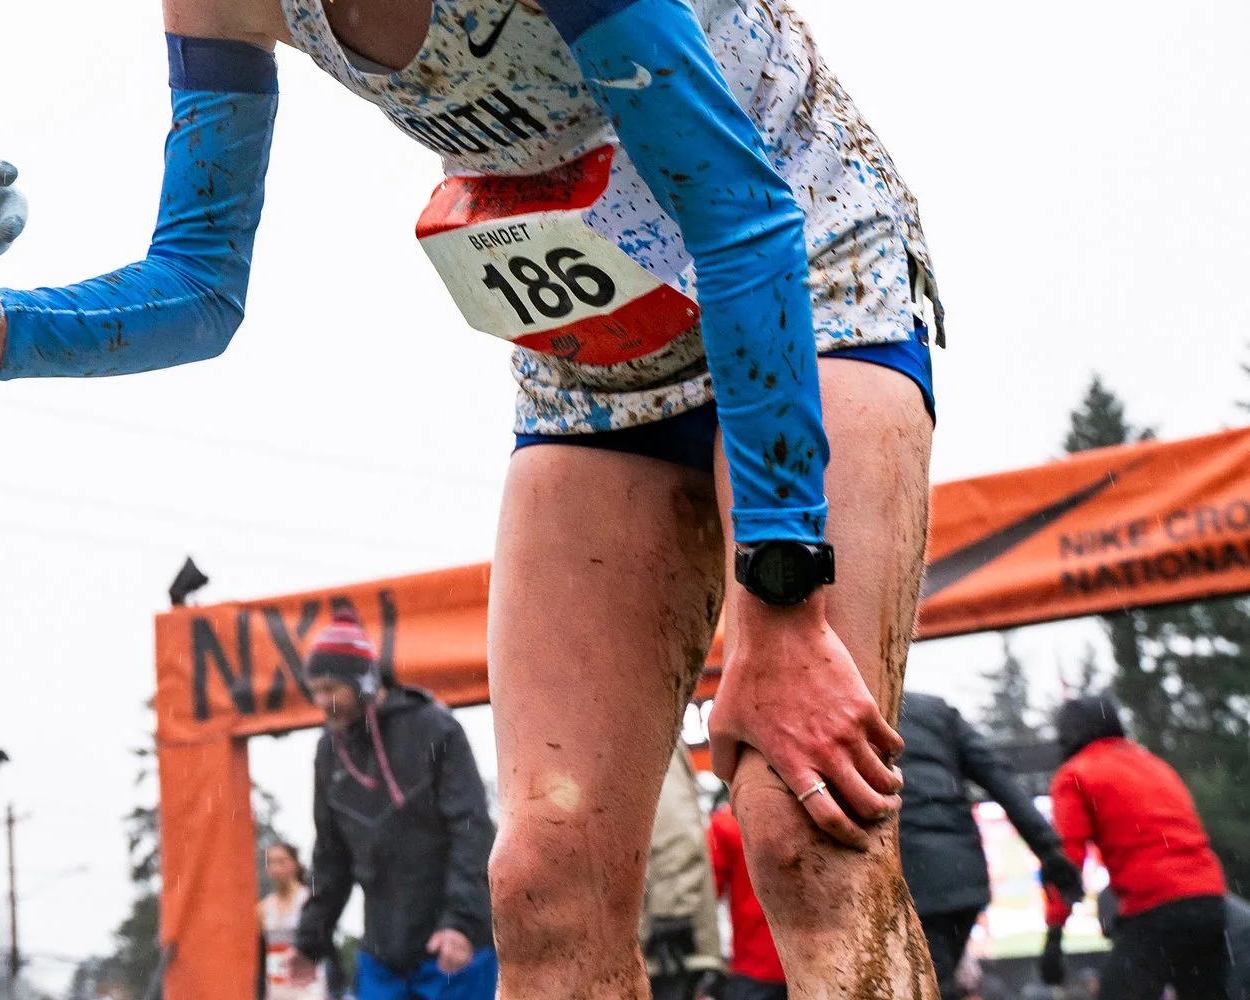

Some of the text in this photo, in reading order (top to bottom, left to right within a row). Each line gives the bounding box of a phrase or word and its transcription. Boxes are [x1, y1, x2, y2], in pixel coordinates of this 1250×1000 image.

[468, 223, 532, 250] BENDET
[481, 247, 616, 326] 186
[1061, 540, 1250, 594] NATIONA
